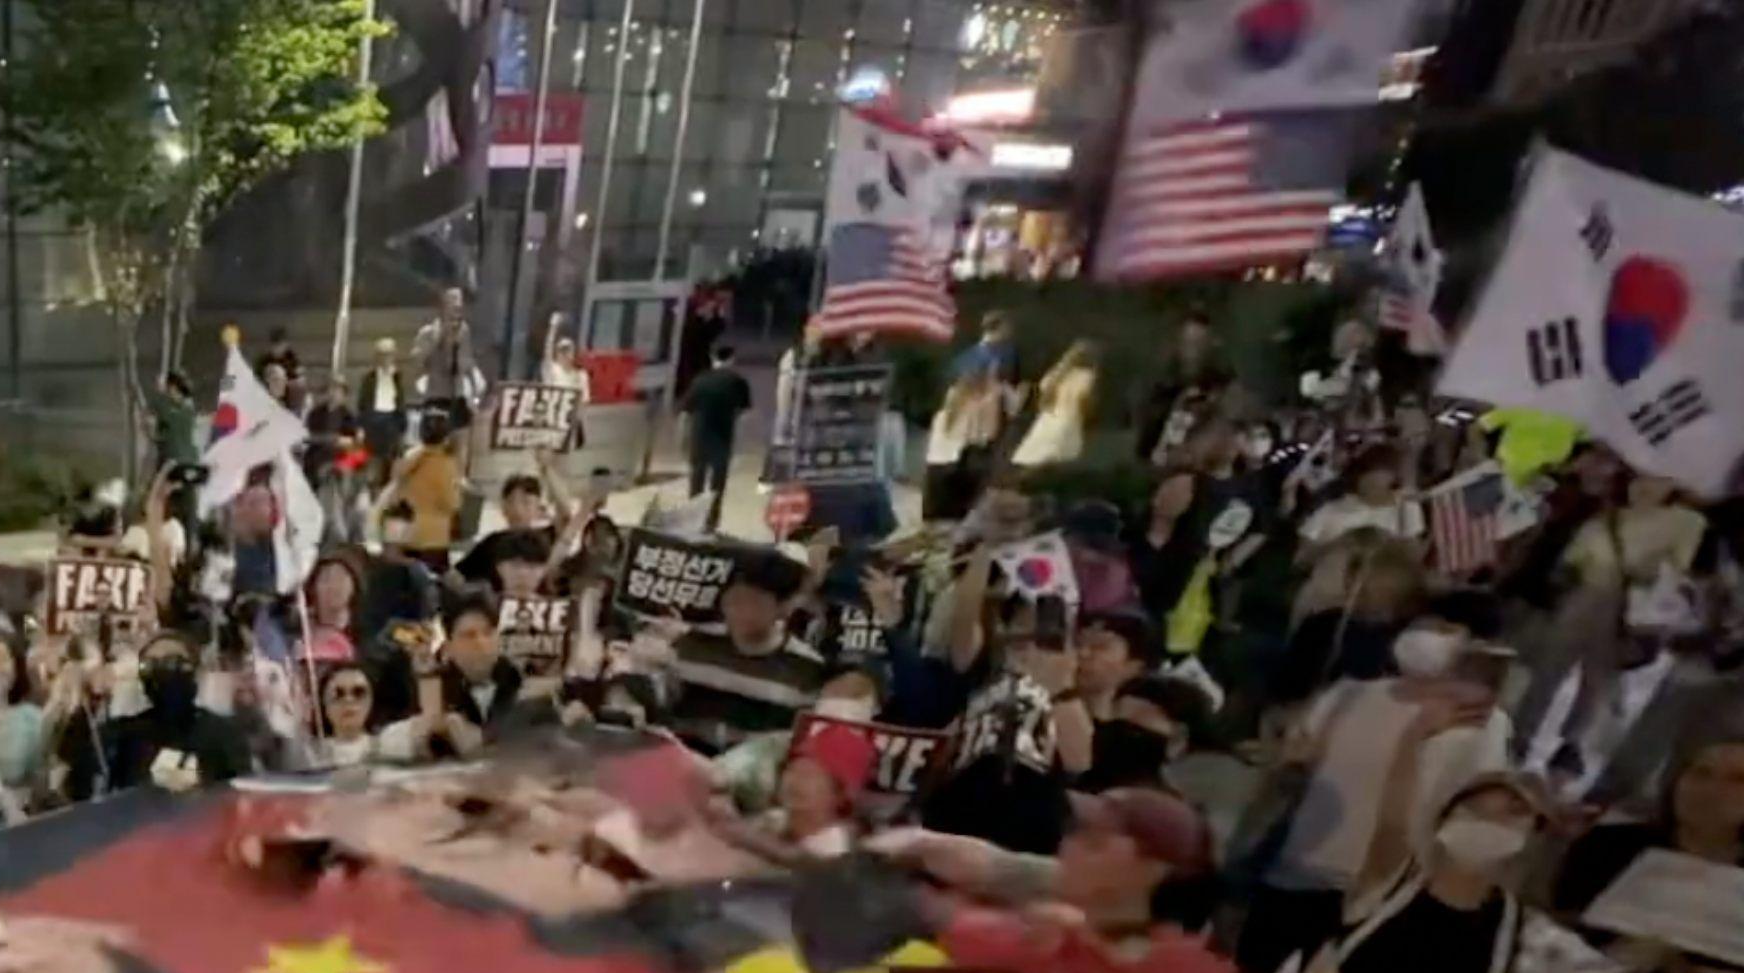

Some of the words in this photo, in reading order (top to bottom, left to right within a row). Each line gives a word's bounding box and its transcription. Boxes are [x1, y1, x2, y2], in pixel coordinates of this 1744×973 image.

[499, 386, 577, 431] FAKE
[635, 544, 736, 584] 부정선거
[498, 598, 572, 632] AKE
